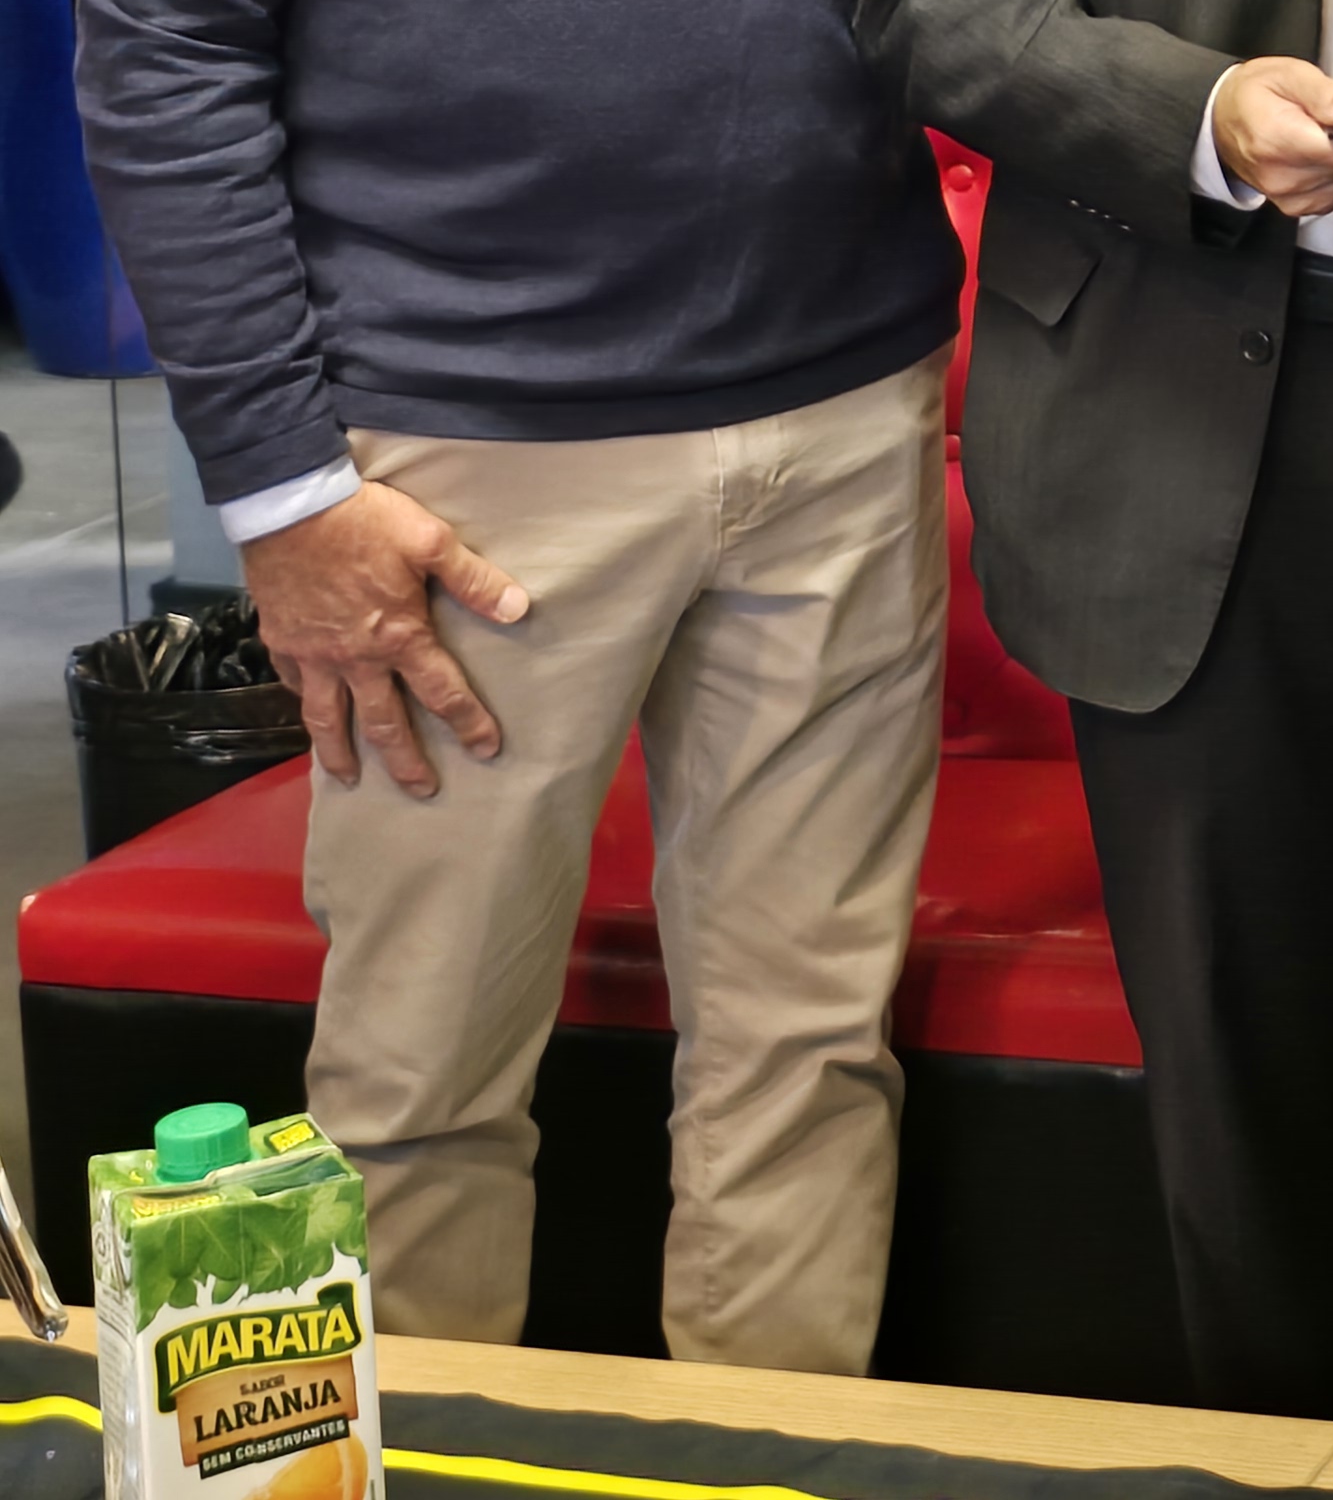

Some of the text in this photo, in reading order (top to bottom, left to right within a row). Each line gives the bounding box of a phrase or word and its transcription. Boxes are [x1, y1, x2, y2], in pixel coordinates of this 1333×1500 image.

[194, 1379, 342, 1443] LARANJA
[202, 1419, 347, 1472] SEM CONSERVANTES
